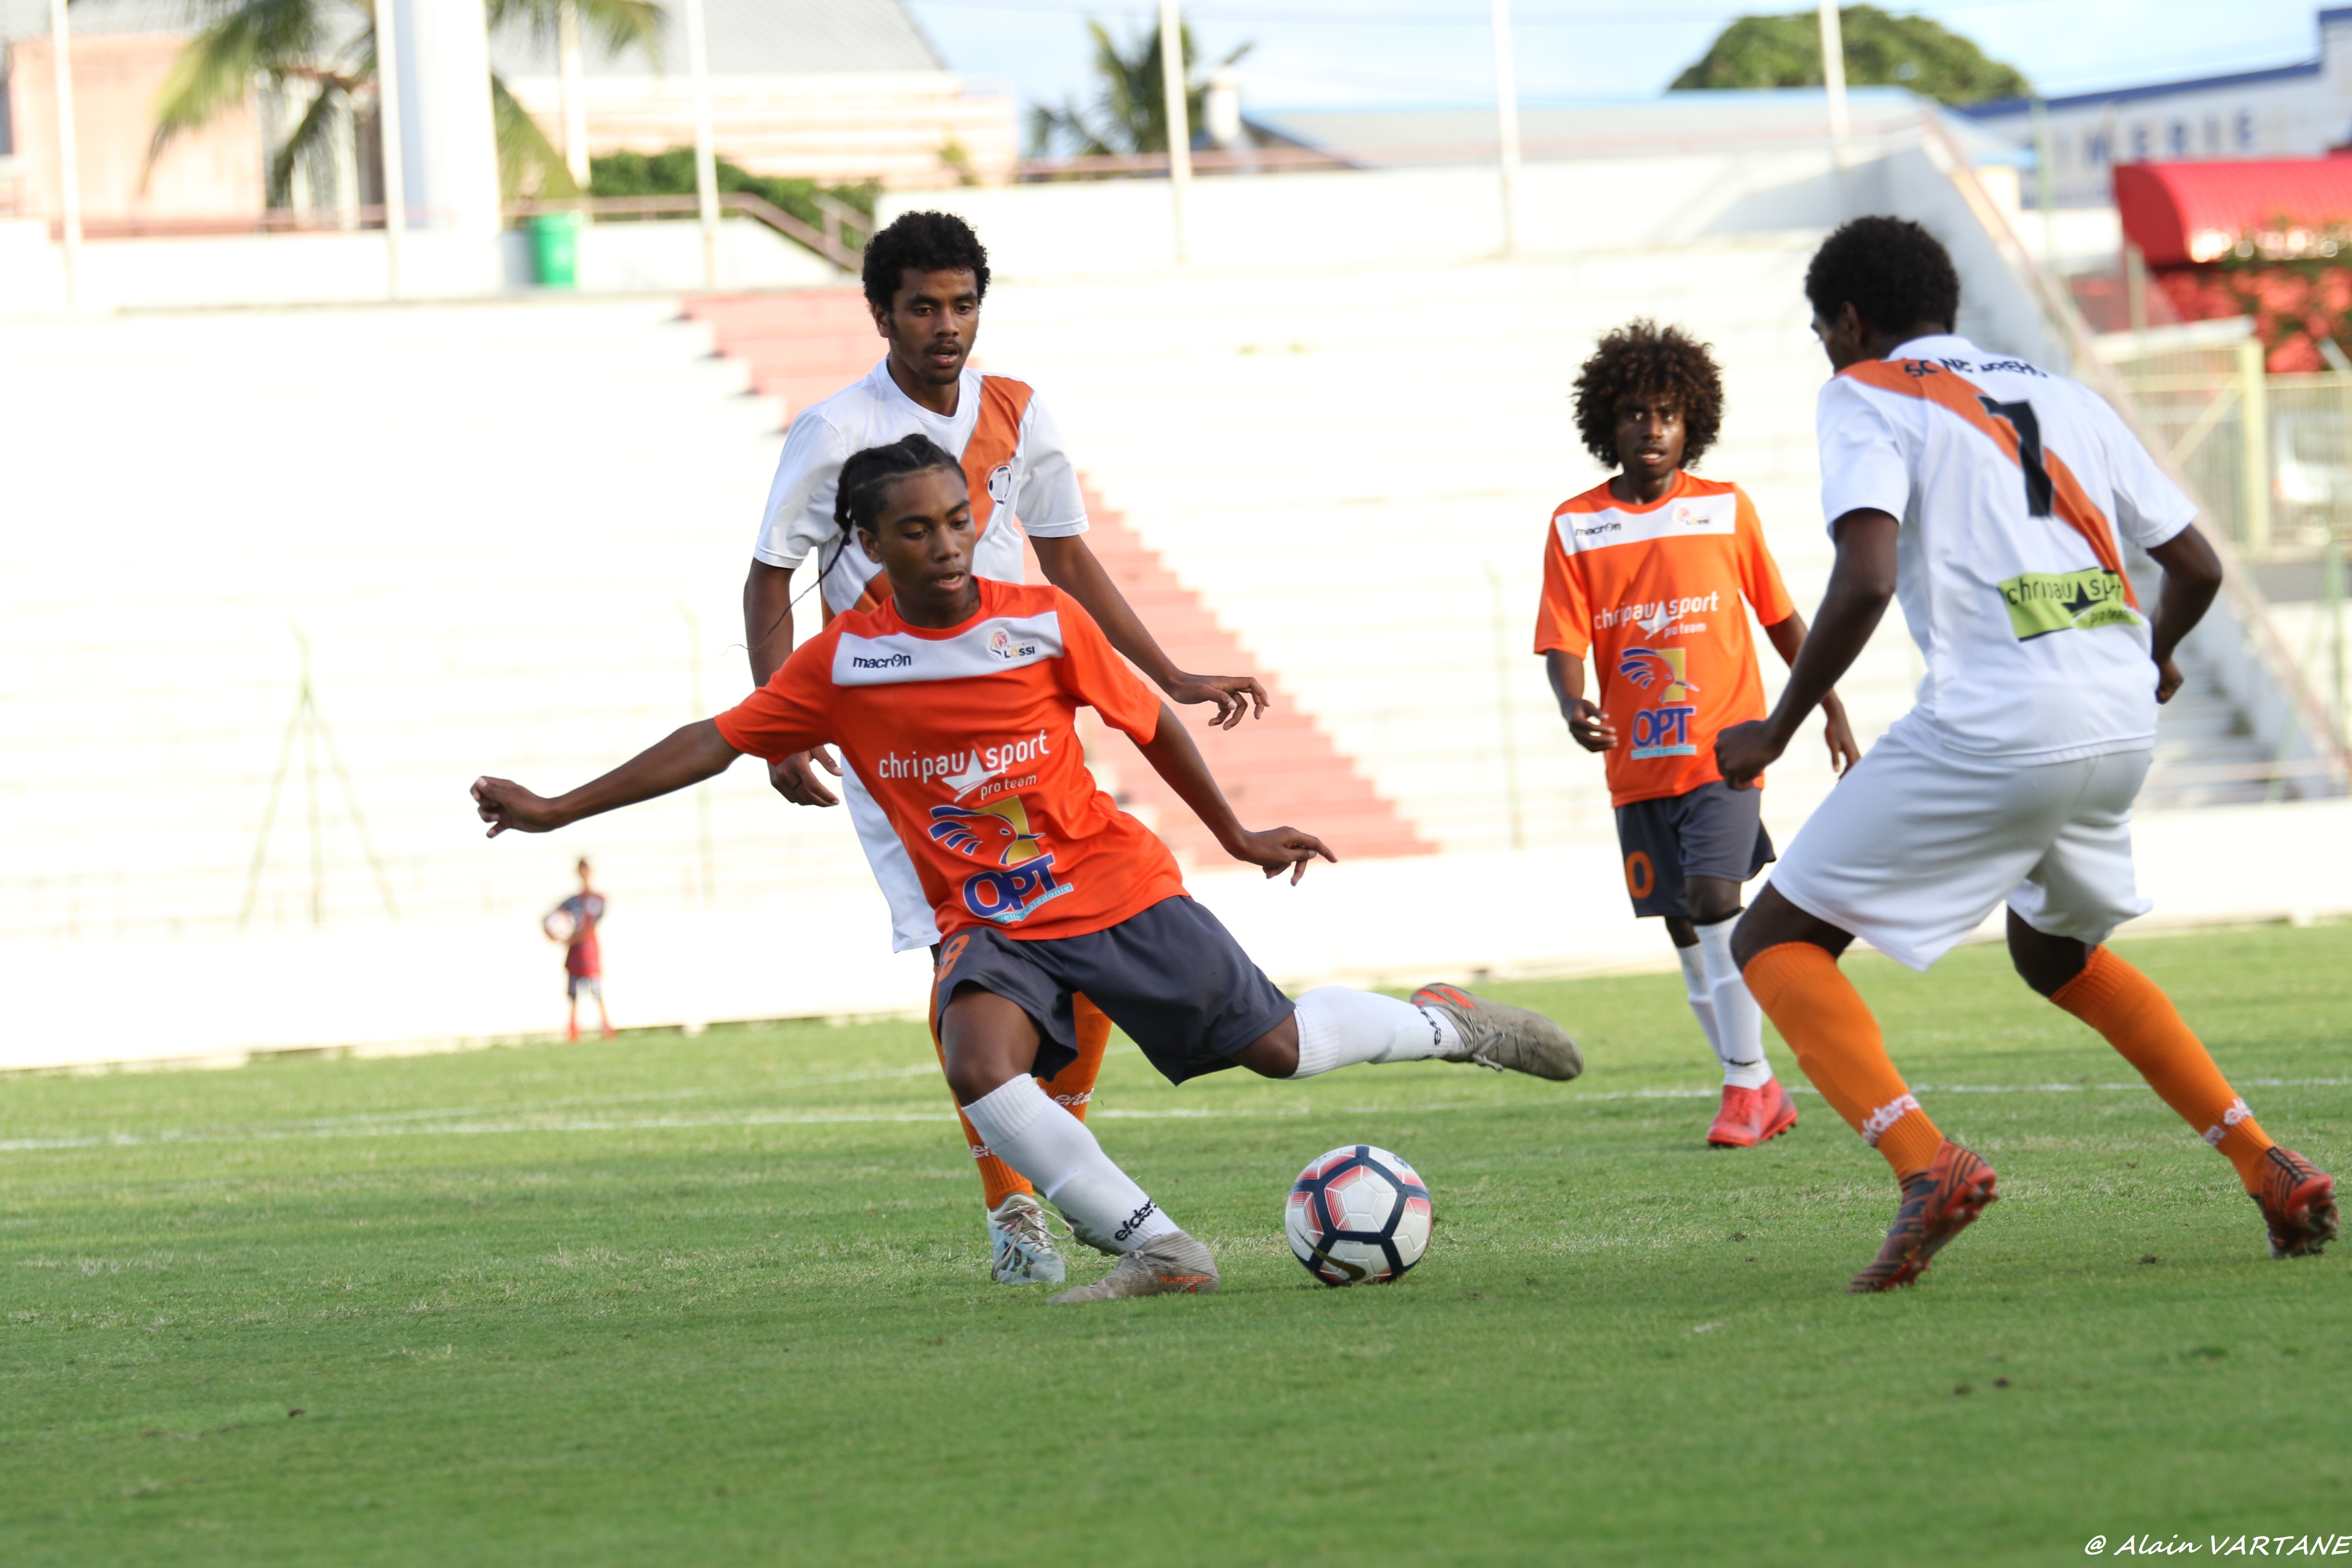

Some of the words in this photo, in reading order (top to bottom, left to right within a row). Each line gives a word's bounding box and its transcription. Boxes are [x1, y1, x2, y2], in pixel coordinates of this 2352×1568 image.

[1905, 359, 1939, 377] SC
[1593, 601, 1655, 630] chripau
[1669, 590, 1720, 619] sport
[1664, 625, 1678, 640] pro
[1679, 622, 1707, 634] team
[852, 654, 912, 668] macron
[1632, 706, 1697, 749] OPT
[879, 751, 965, 784] chripau
[986, 729, 1050, 774] sport
[980, 783, 1001, 800] pro
[1004, 774, 1038, 790] team
[962, 852, 1056, 919] OPT
[1160, 1275, 1209, 1284] NEMESIS
